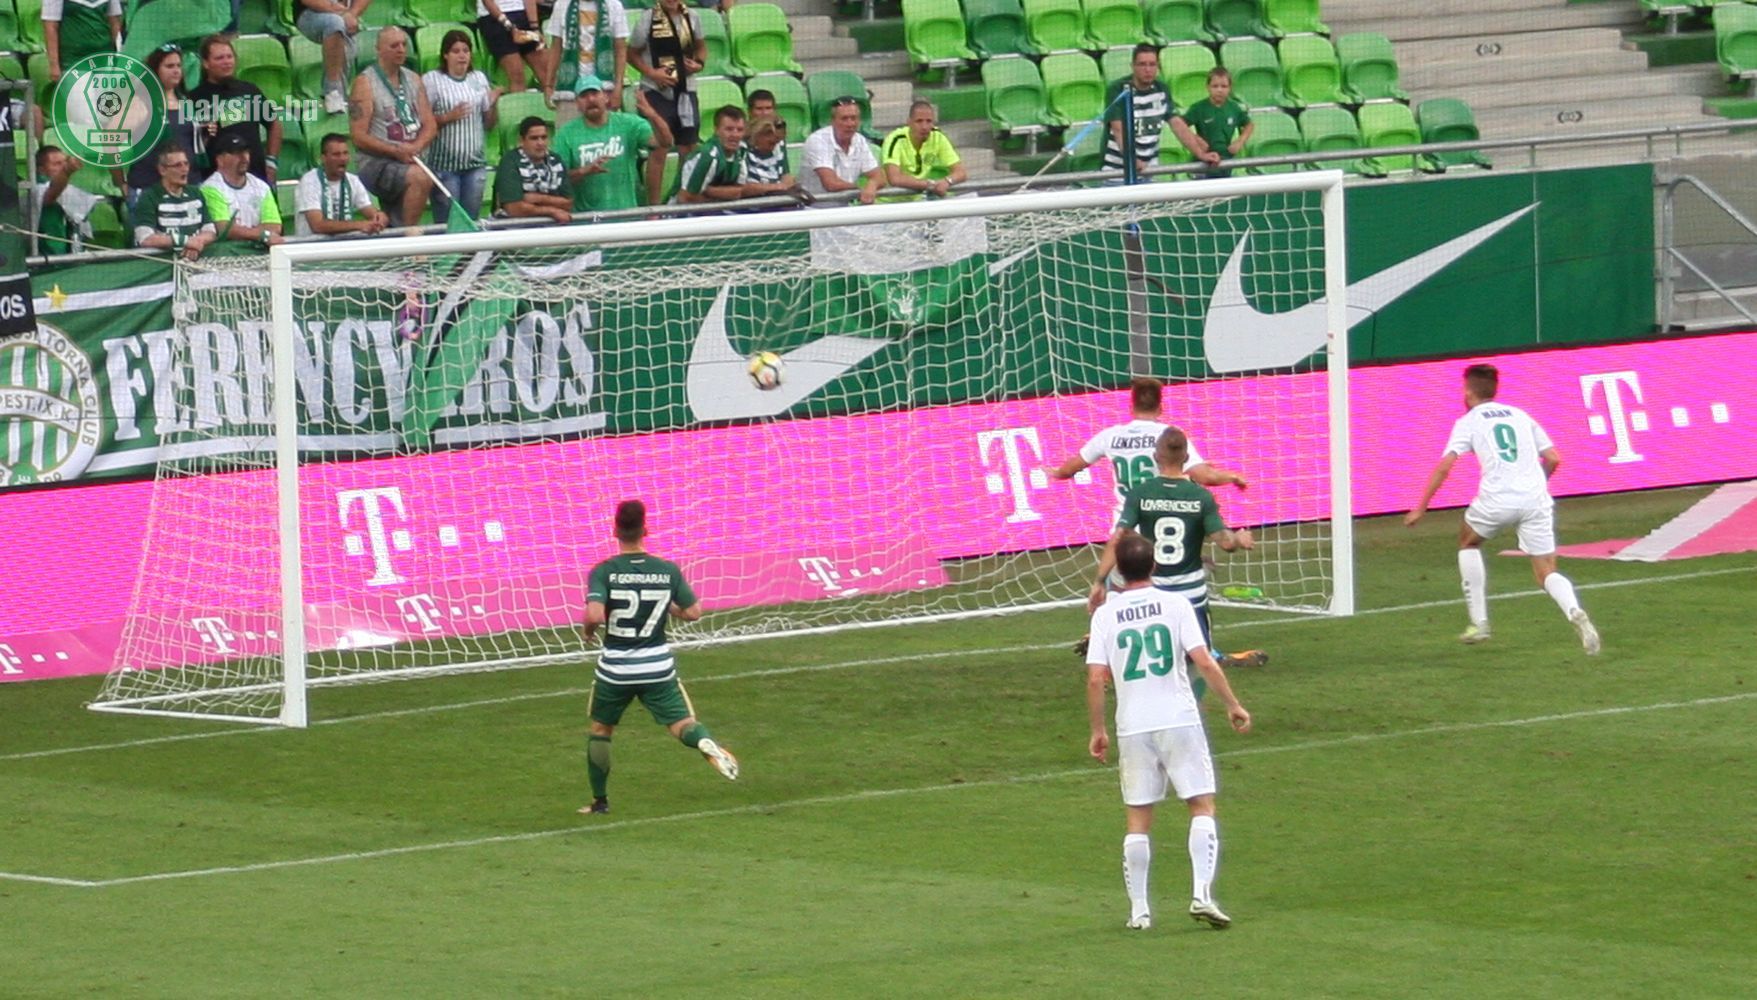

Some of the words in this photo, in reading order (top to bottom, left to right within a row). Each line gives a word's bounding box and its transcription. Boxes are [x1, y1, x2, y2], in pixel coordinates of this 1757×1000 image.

[46, 330, 90, 388] TORNA
[82, 395, 97, 447] CLUB
[1493, 423, 1518, 463] 9
[1154, 516, 1186, 565] 8
[608, 589, 671, 637] 27
[1116, 602, 1162, 623] KOLTAI
[1117, 623, 1174, 682] 29
